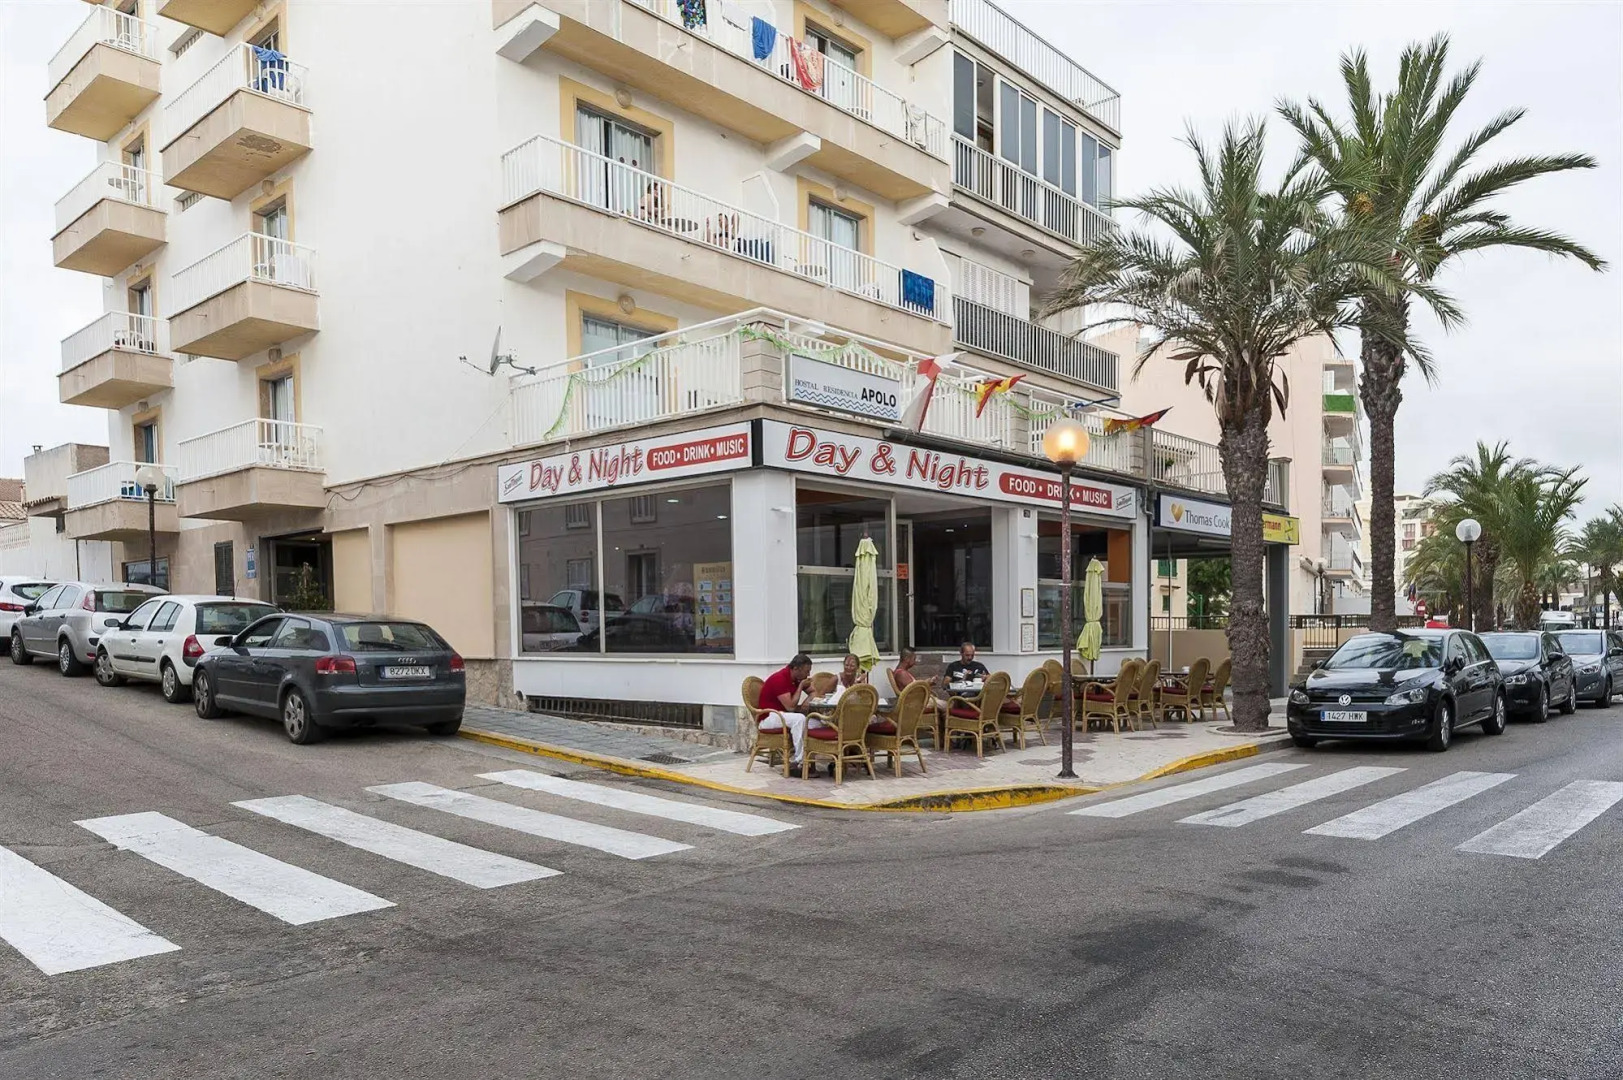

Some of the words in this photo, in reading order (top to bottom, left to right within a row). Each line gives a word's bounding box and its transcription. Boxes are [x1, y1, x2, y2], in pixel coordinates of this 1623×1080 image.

[794, 378, 819, 390] HOSTAL
[823, 385, 858, 399] RESIDENCIA
[861, 387, 897, 407] APOLO
[651, 450, 676, 467] FOOD
[683, 443, 711, 462] DRINK
[715, 438, 745, 457] MUSIC
[785, 426, 862, 476] Day
[870, 441, 897, 477] &
[905, 448, 989, 492] Night
[528, 460, 565, 495] Day
[567, 453, 582, 487] &
[588, 444, 644, 485] Night
[1008, 477, 1037, 494] FOOD
[1046, 483, 1076, 501] DRIK
[1082, 489, 1108, 506] MUSIC
[1184, 509, 1213, 528] Thomas
[1213, 514, 1231, 529] Cook
[1327, 712, 1346, 720] 1427
